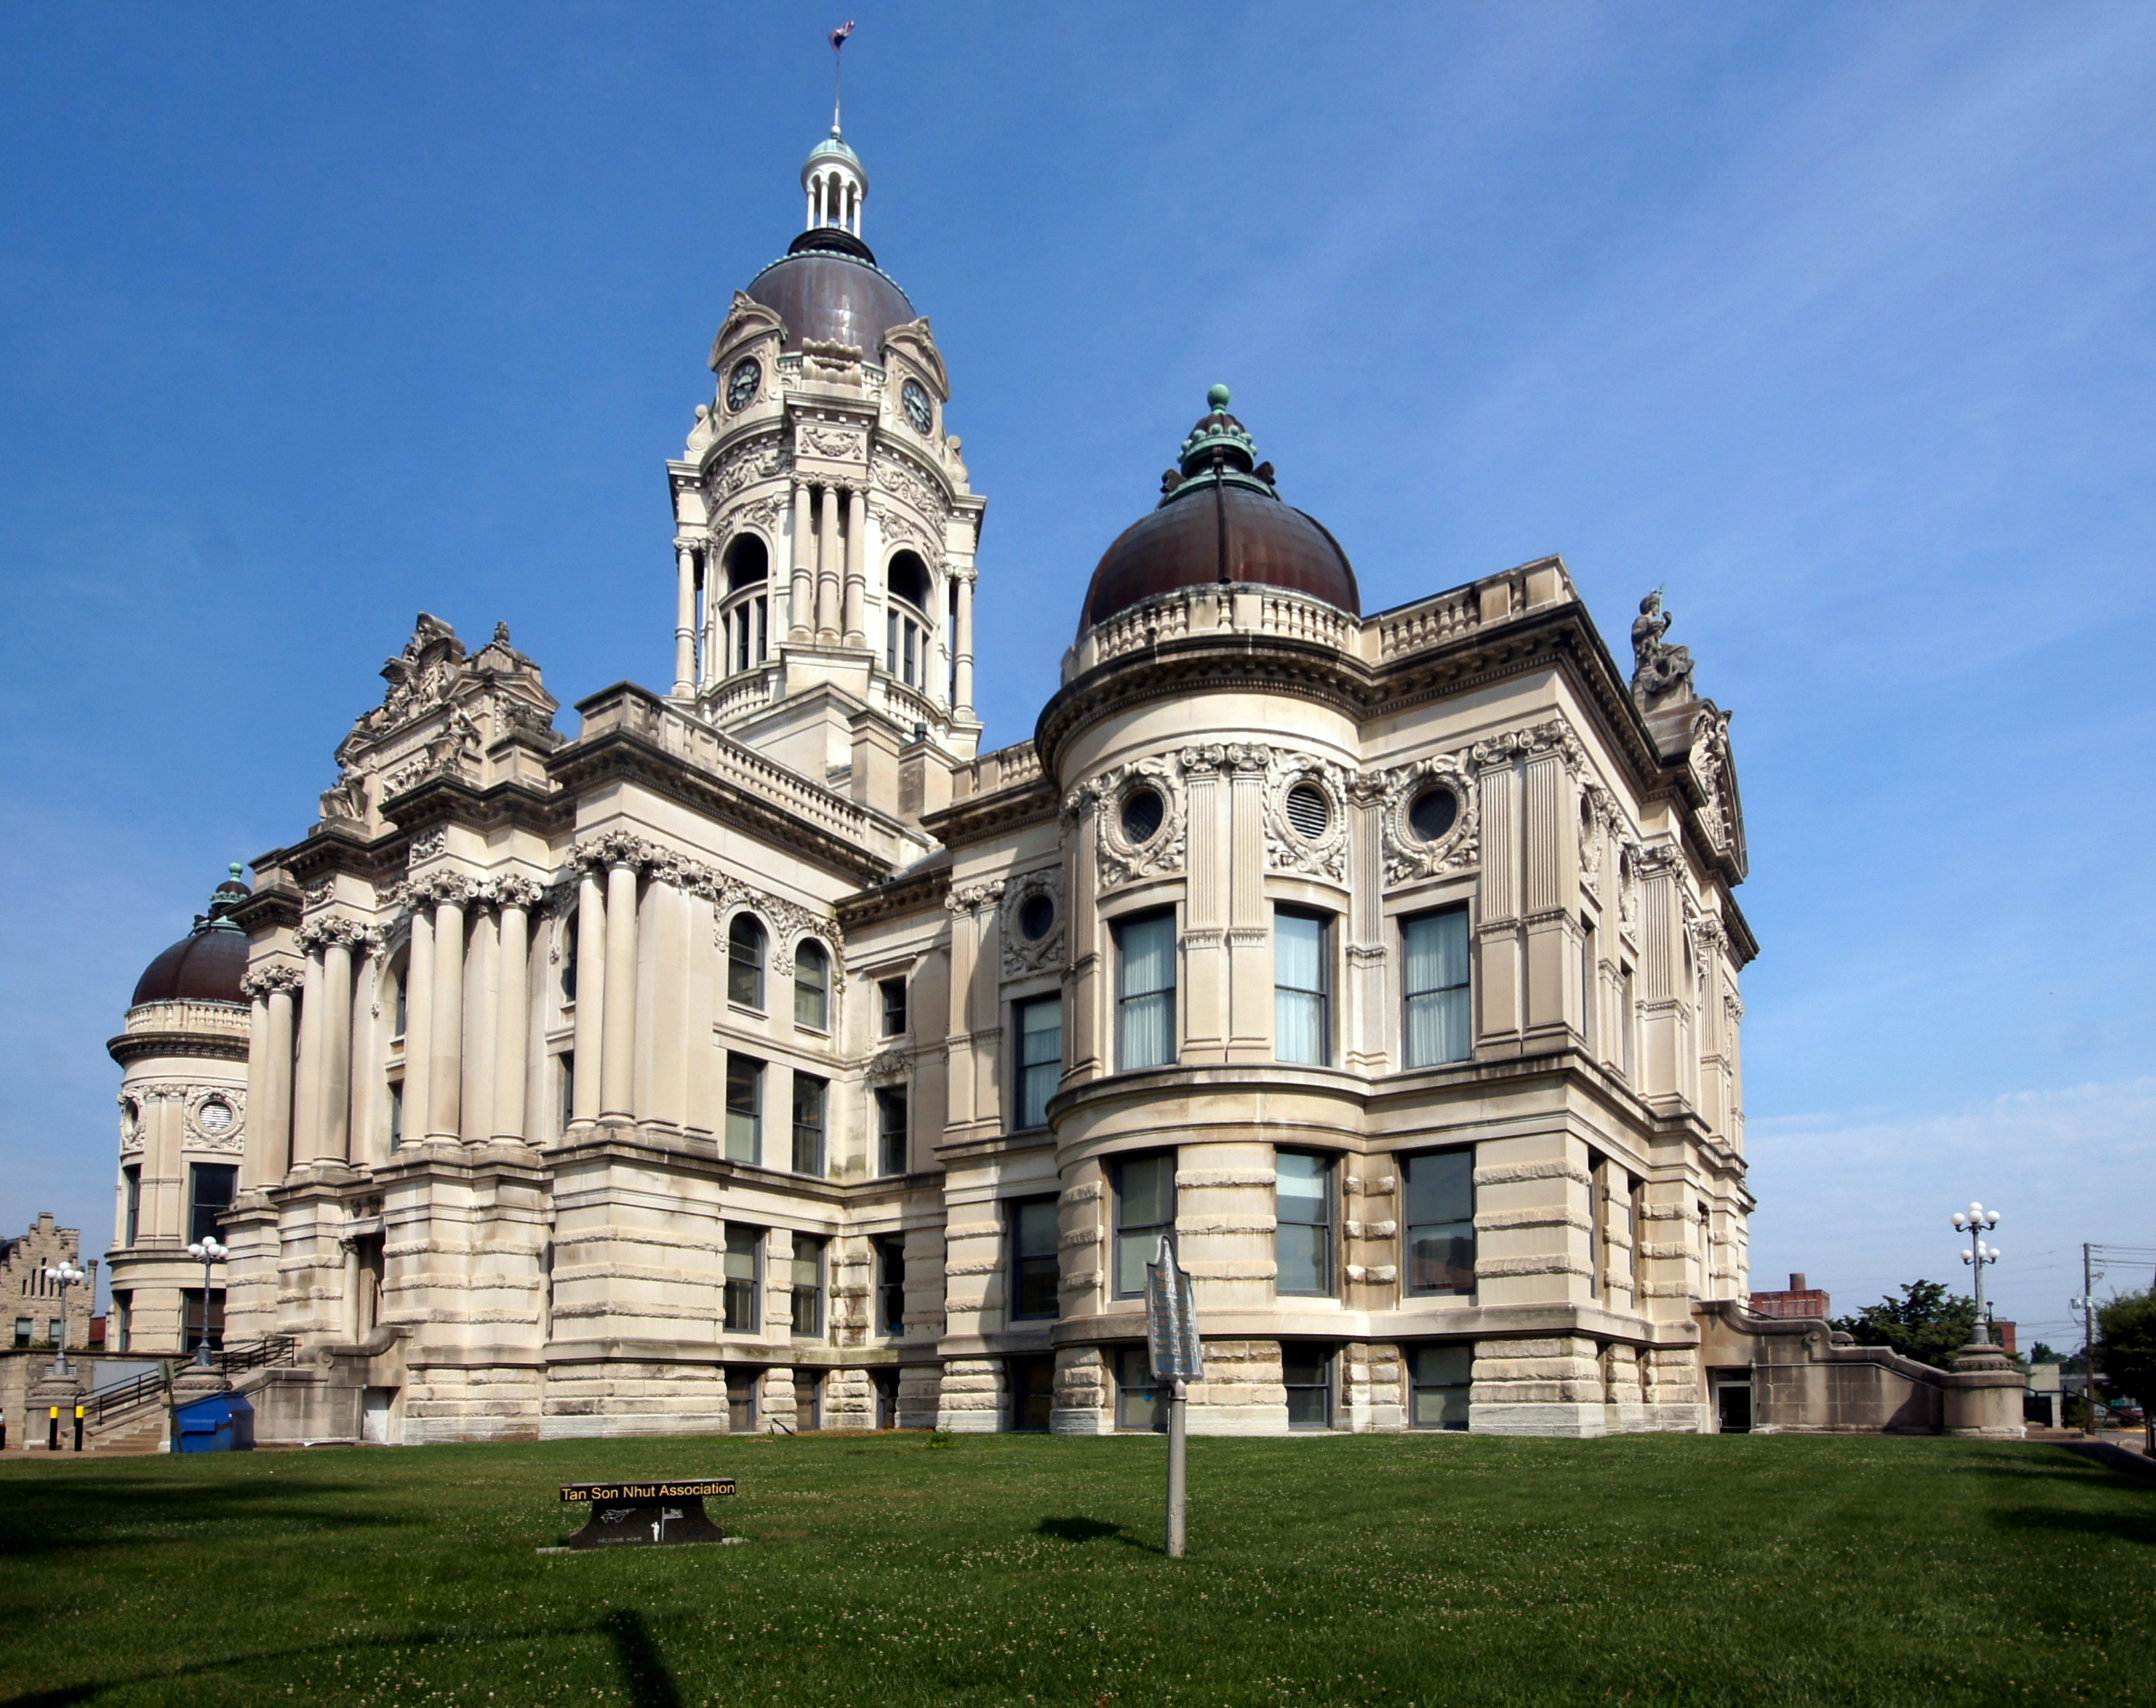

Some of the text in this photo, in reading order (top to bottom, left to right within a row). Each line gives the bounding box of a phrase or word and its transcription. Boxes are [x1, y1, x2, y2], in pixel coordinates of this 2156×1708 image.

[562, 1482, 735, 1501] Tan Son Nhut Association
